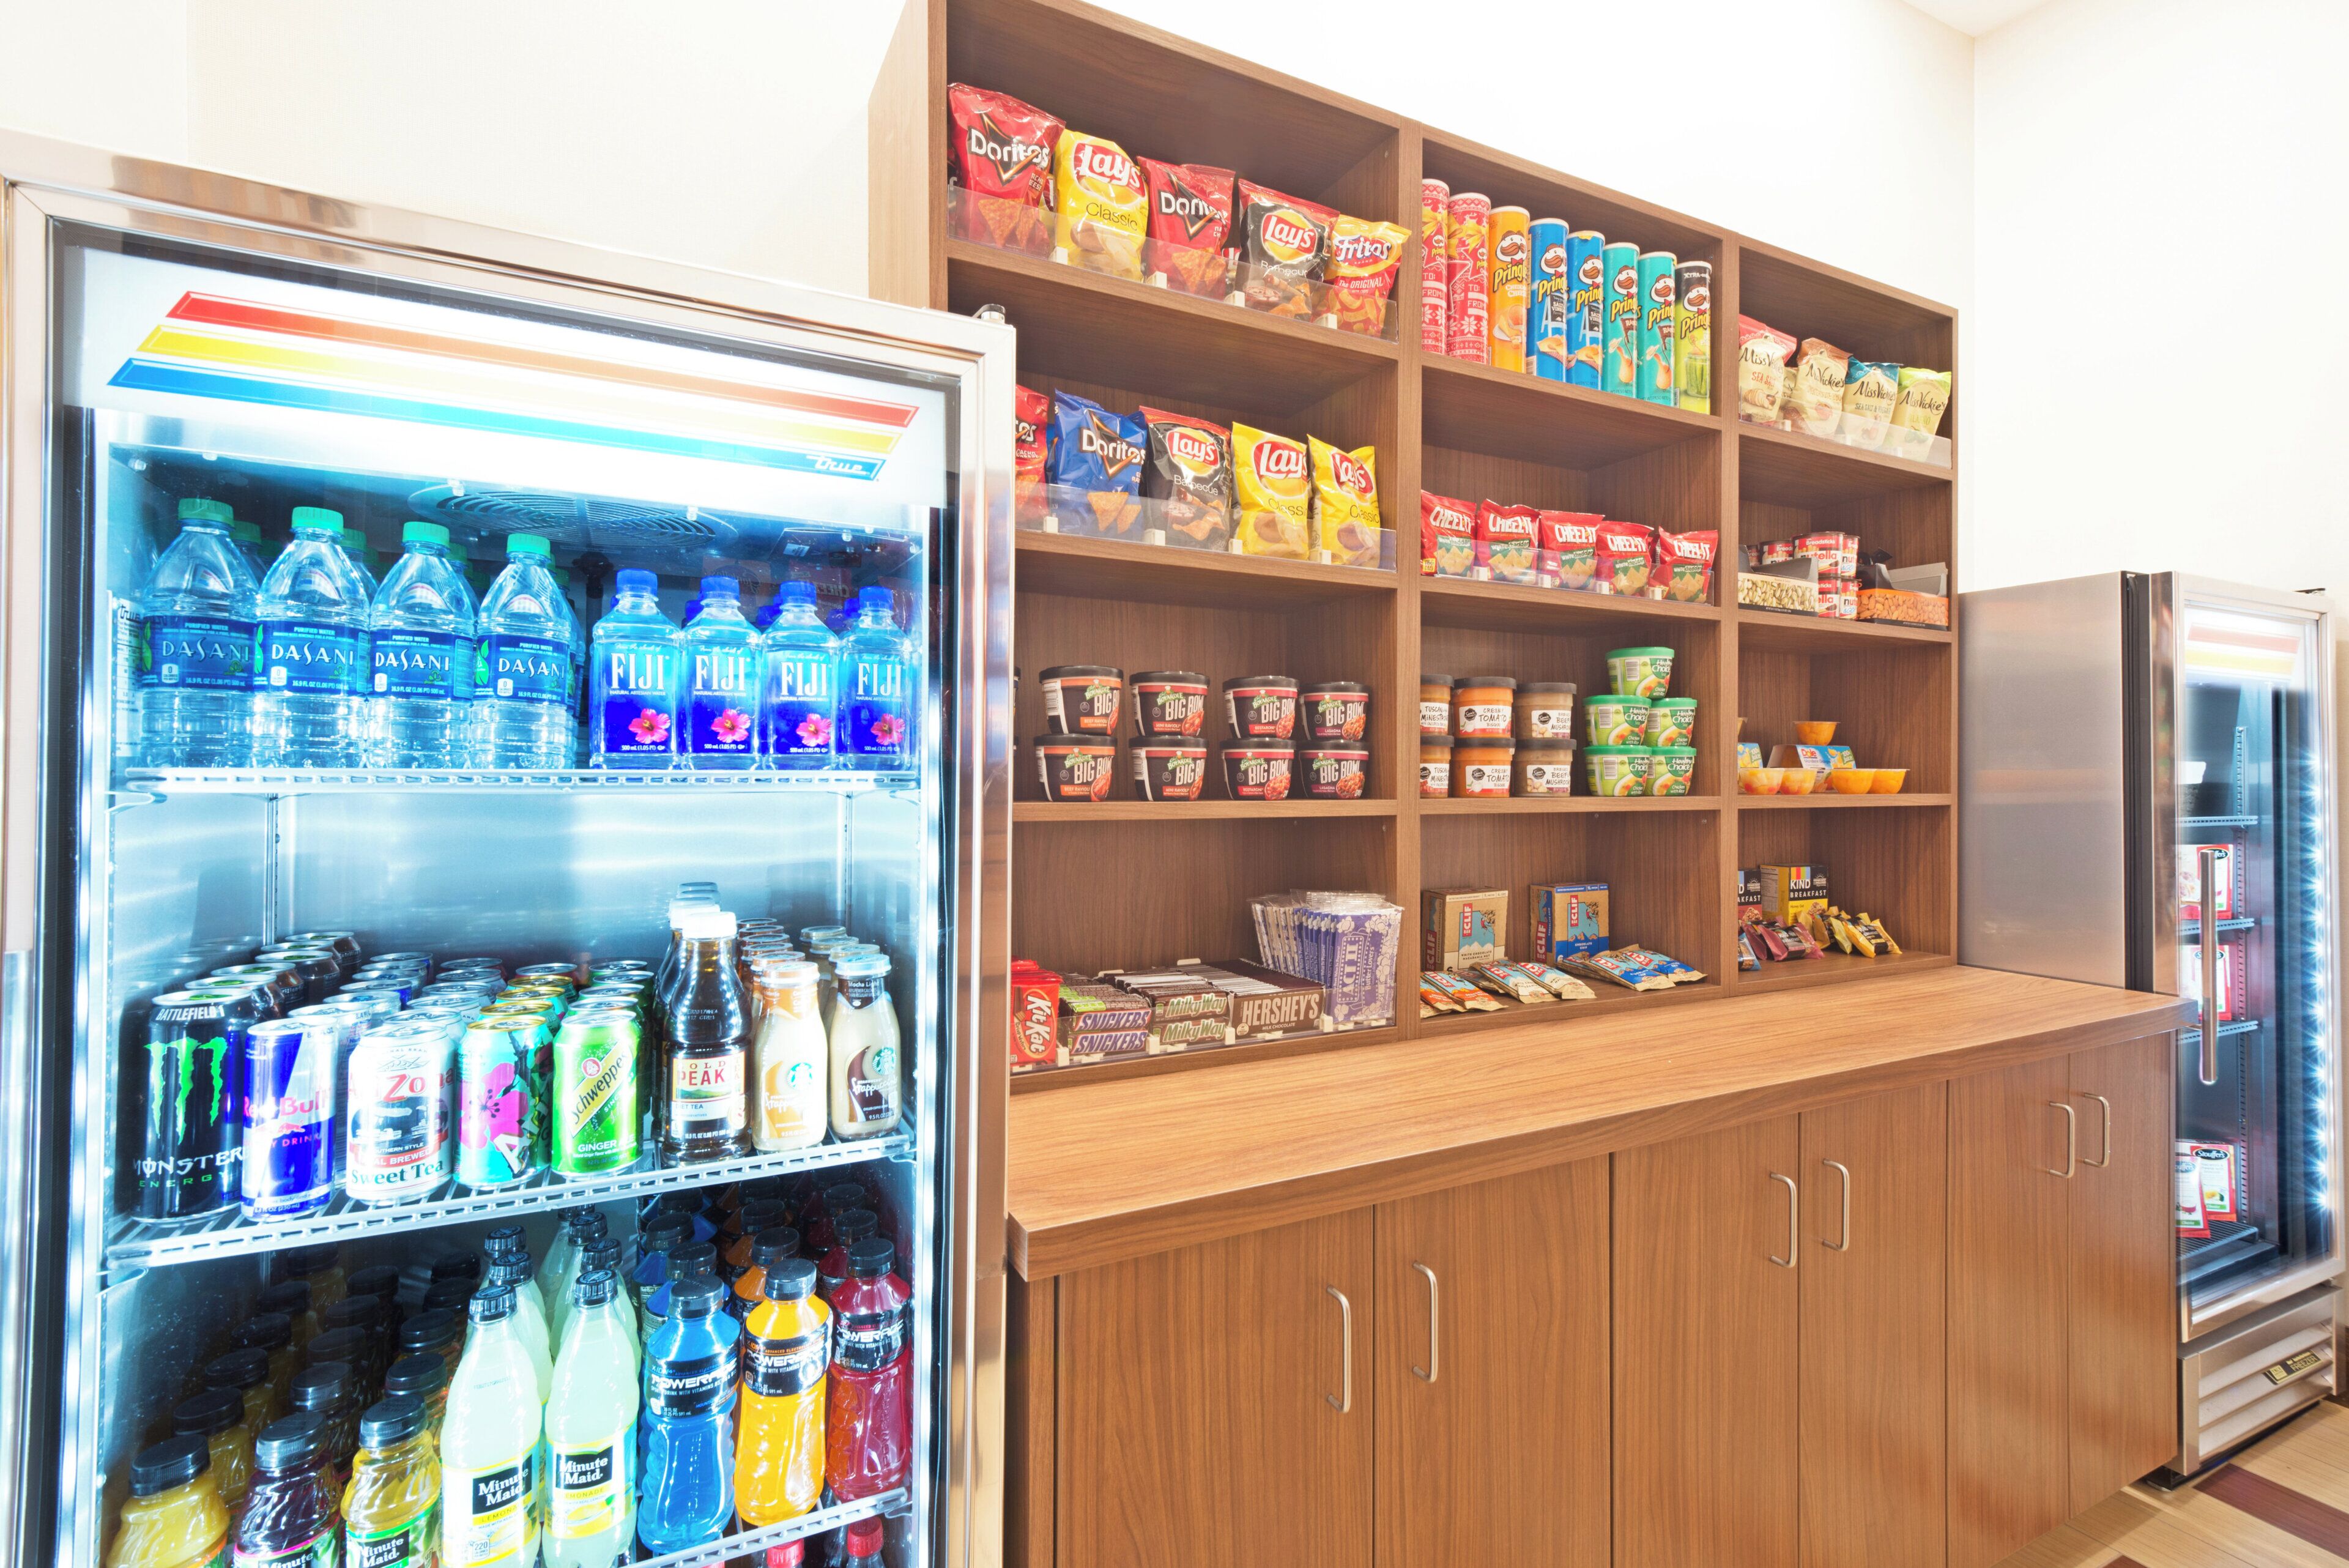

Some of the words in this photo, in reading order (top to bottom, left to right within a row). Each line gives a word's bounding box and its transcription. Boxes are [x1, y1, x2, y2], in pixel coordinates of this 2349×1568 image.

[970, 127, 1050, 167] Doritos
[1086, 202, 1138, 232] Classic
[1264, 215, 1315, 249] Lay's
[1335, 235, 1392, 261] Fritos
[1339, 279, 1350, 288] The
[1349, 277, 1384, 289] ORIGINAL
[1422, 289, 1444, 299] FROM:
[1739, 347, 1767, 366] Miss
[1752, 371, 1764, 384] SEA
[1817, 366, 1845, 392] Vickie's
[1853, 381, 1876, 398] Miss
[1920, 391, 1947, 416] Vickie's
[1082, 429, 1146, 464] Doritos
[1172, 433, 1217, 463] Lay's
[1349, 504, 1379, 524] Classic
[163, 637, 249, 662] DASANI
[272, 642, 354, 666] DASANI
[375, 648, 449, 672] DASANI
[499, 656, 565, 678] DASANI
[610, 653, 665, 689] FIJI
[694, 655, 746, 691] FIJI
[781, 661, 828, 696] FIJI
[857, 663, 903, 696] FIJI
[1094, 693, 1112, 716] BIG
[1165, 699, 1186, 721] BIG
[1261, 701, 1280, 724] BIG
[1326, 705, 1345, 727] BIG
[1801, 748, 1817, 758] Dole
[1074, 760, 1095, 784] BIG
[1176, 764, 1195, 786] BIG
[1249, 764, 1268, 786] BIG
[1319, 764, 1339, 784] BIG
[1668, 762, 1691, 771] Choice
[1790, 890, 1827, 898] BREAKFAST
[1791, 879, 1811, 890] KIND
[1463, 906, 1472, 929] CLIF
[1427, 933, 1435, 964] CLIF
[1537, 924, 1547, 953] CLIF
[1367, 946, 1375, 967] Lovers
[1342, 964, 1356, 995] ACT
[156, 1006, 216, 1021] BATTLEFIELD
[218, 1005, 225, 1017] 1
[1166, 997, 1202, 1018] Milky
[1201, 993, 1227, 1015] Way
[1242, 994, 1319, 1027] HERSHEY'S
[1078, 1010, 1151, 1031] SNICKERS
[1163, 1021, 1200, 1042] Milky
[1199, 1019, 1225, 1039] Way
[1075, 1031, 1148, 1053] SNICKERS
[573, 1048, 630, 1124] Schweppes
[282, 1134, 321, 1148] DRINK
[404, 1142, 424, 1150] STYLE
[577, 1139, 617, 1152] GINGER
[2197, 1150, 2225, 1159] Stouffer's
[351, 1167, 407, 1186] Sweet
[410, 1160, 443, 1178] Tea
[779, 1362, 800, 1373] VITAMINS
[2290, 1355, 2318, 1372] FREEZER
[692, 1383, 714, 1394] VITAMINS
[559, 1456, 609, 1476] Minute
[564, 1467, 603, 1485] Maid
[478, 1468, 529, 1496] Minute
[485, 1481, 524, 1506] Maid
[474, 1541, 488, 1551] 220
